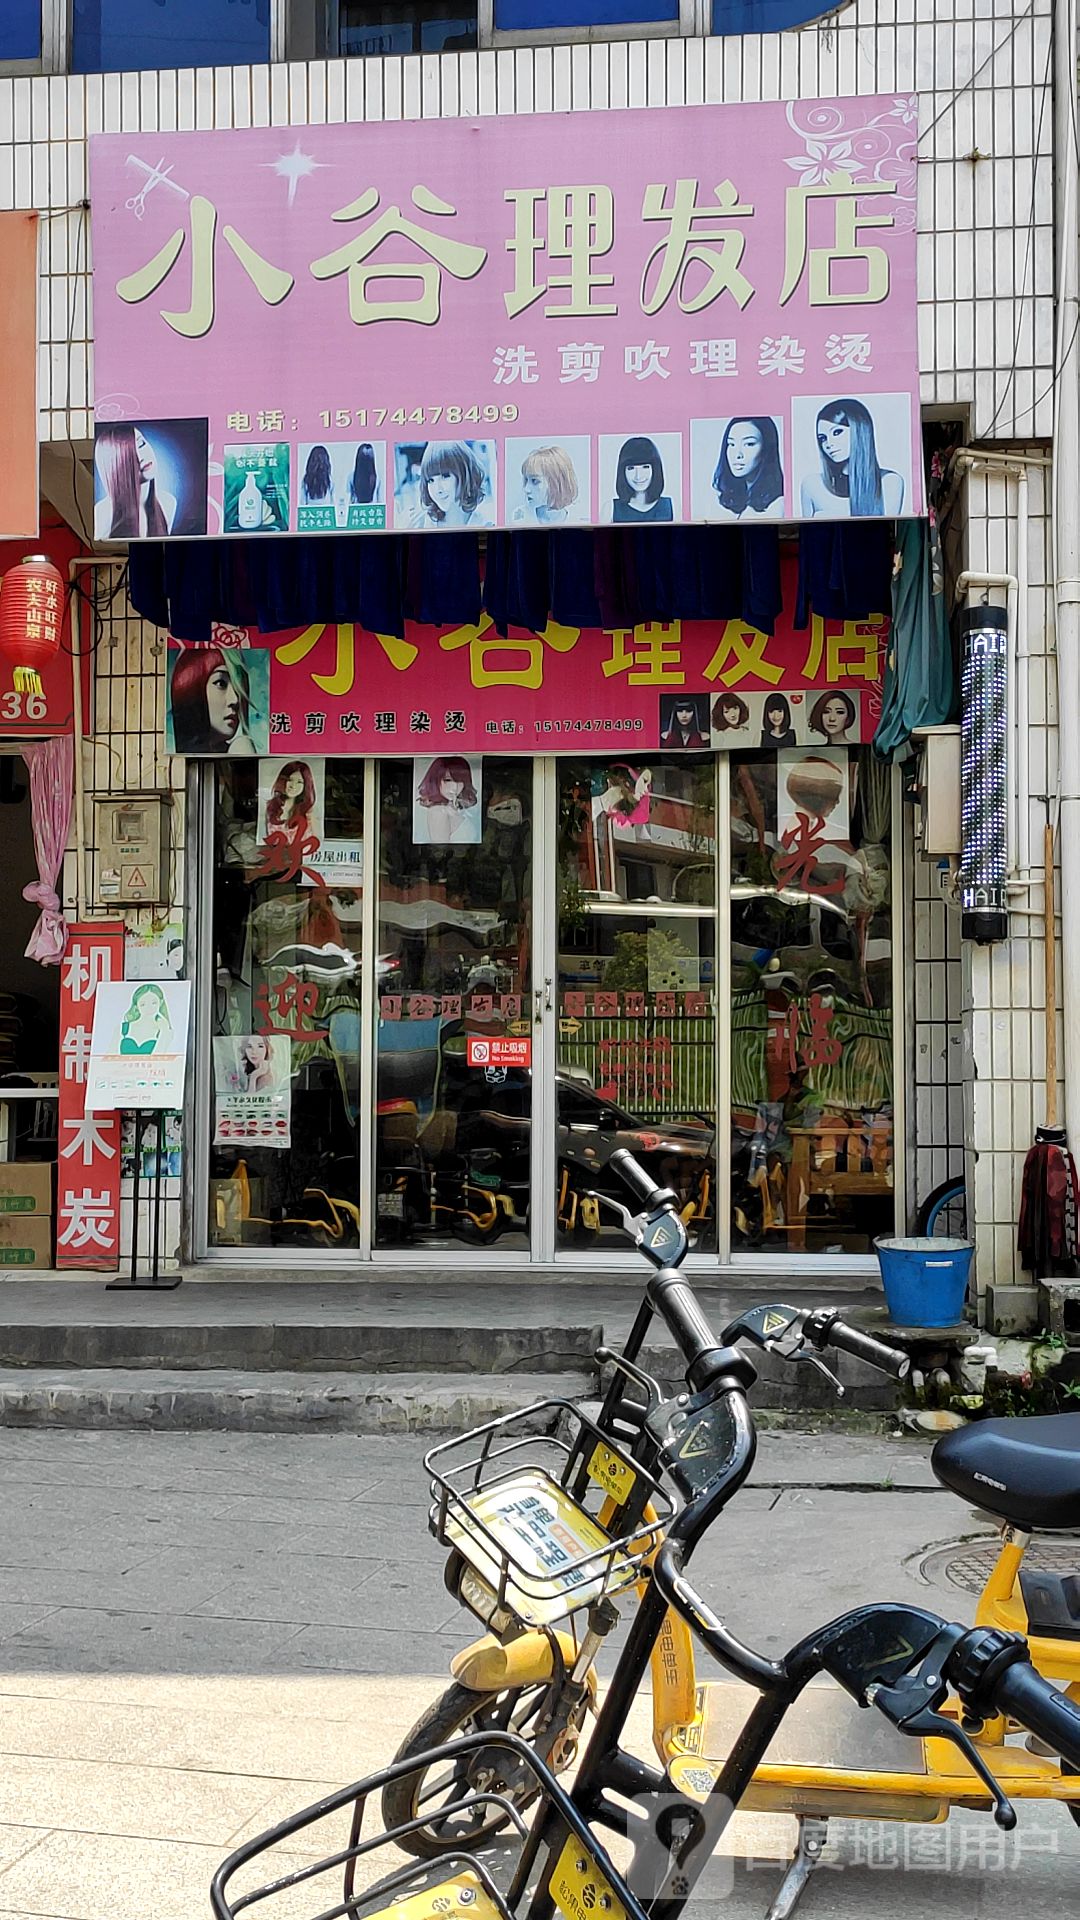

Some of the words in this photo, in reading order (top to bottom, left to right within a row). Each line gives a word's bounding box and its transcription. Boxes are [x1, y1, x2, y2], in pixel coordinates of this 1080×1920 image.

[116, 169, 897, 338] 小谷理发店
[492, 333, 873, 385] 洗剪吹理染烫
[319, 404, 519, 428] 15174478499
[269, 711, 466, 734] 洗剪吹理染烫
[534, 719, 643, 732] 15174478499
[491, 1042, 527, 1054] 禁止吸烟
